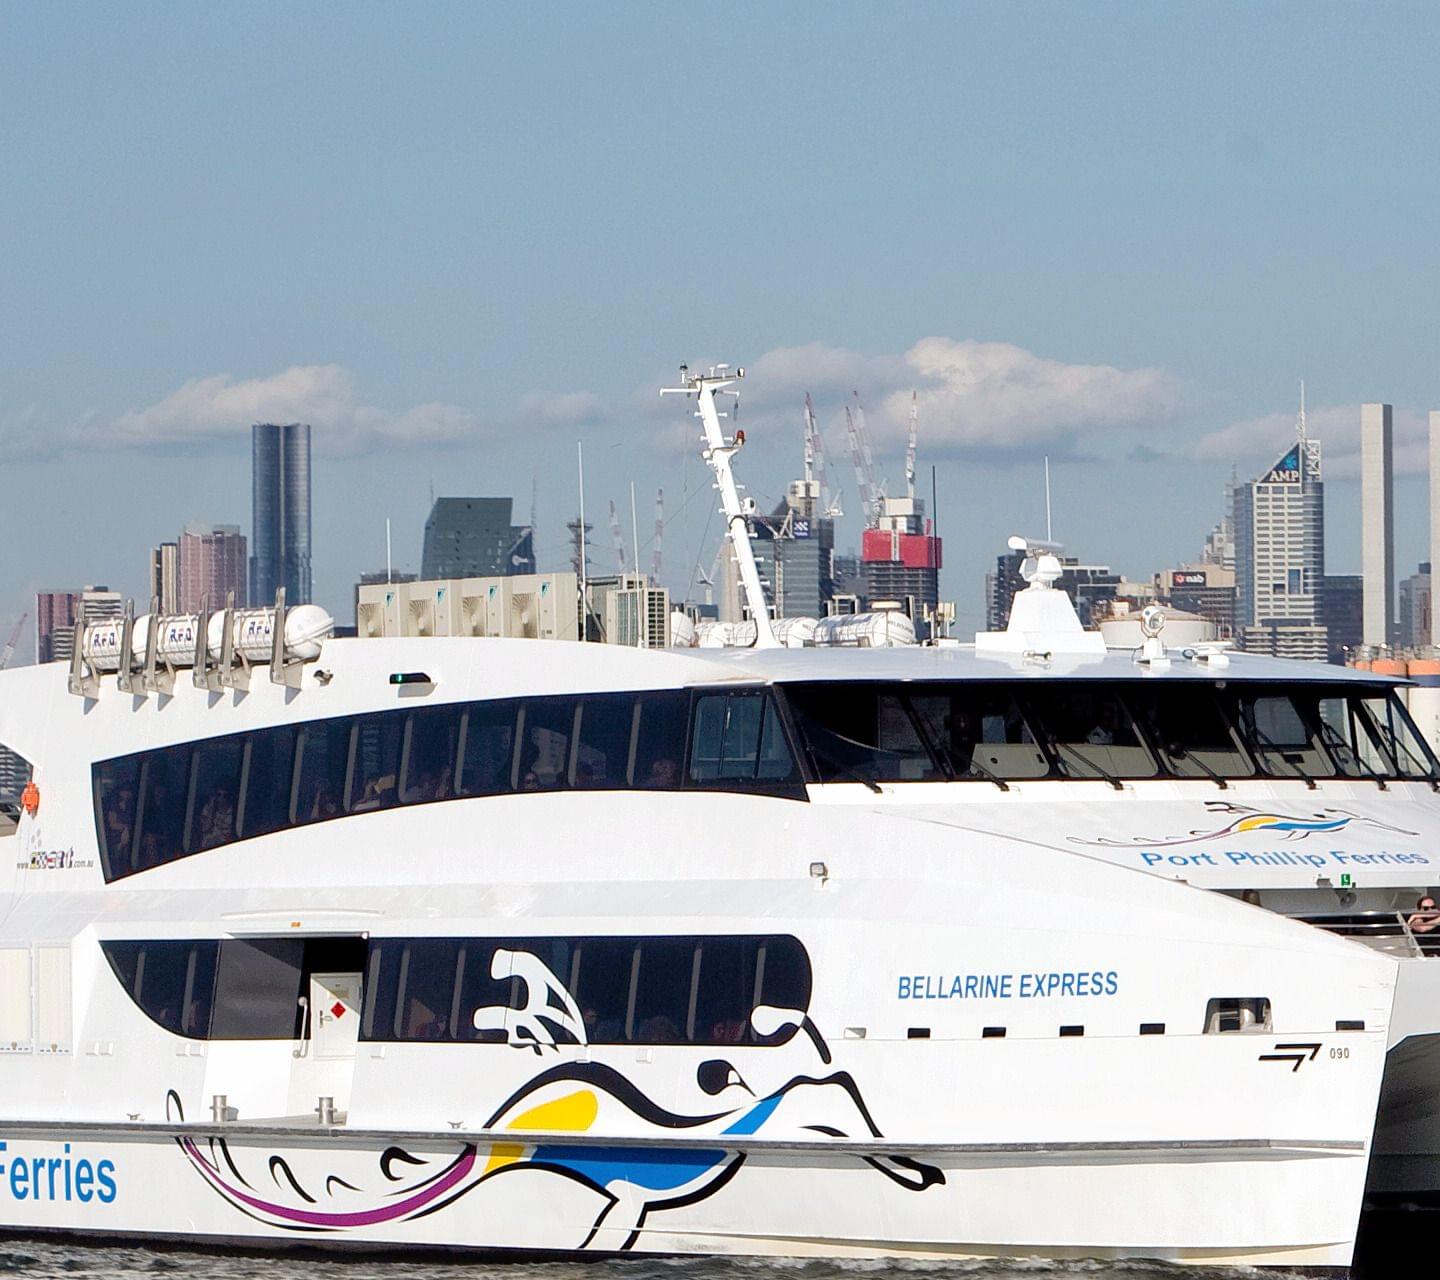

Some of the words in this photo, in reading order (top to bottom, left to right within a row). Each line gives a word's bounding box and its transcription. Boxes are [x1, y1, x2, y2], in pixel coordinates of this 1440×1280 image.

[1269, 470, 1299, 482] AMP
[1140, 852, 1218, 867] Port
[1224, 851, 1327, 869] Phillip
[1330, 850, 1431, 866] Ferries
[897, 974, 1013, 999] BELLARINE
[1019, 971, 1119, 998] EXPRESS
[1329, 1047, 1350, 1060] 090
